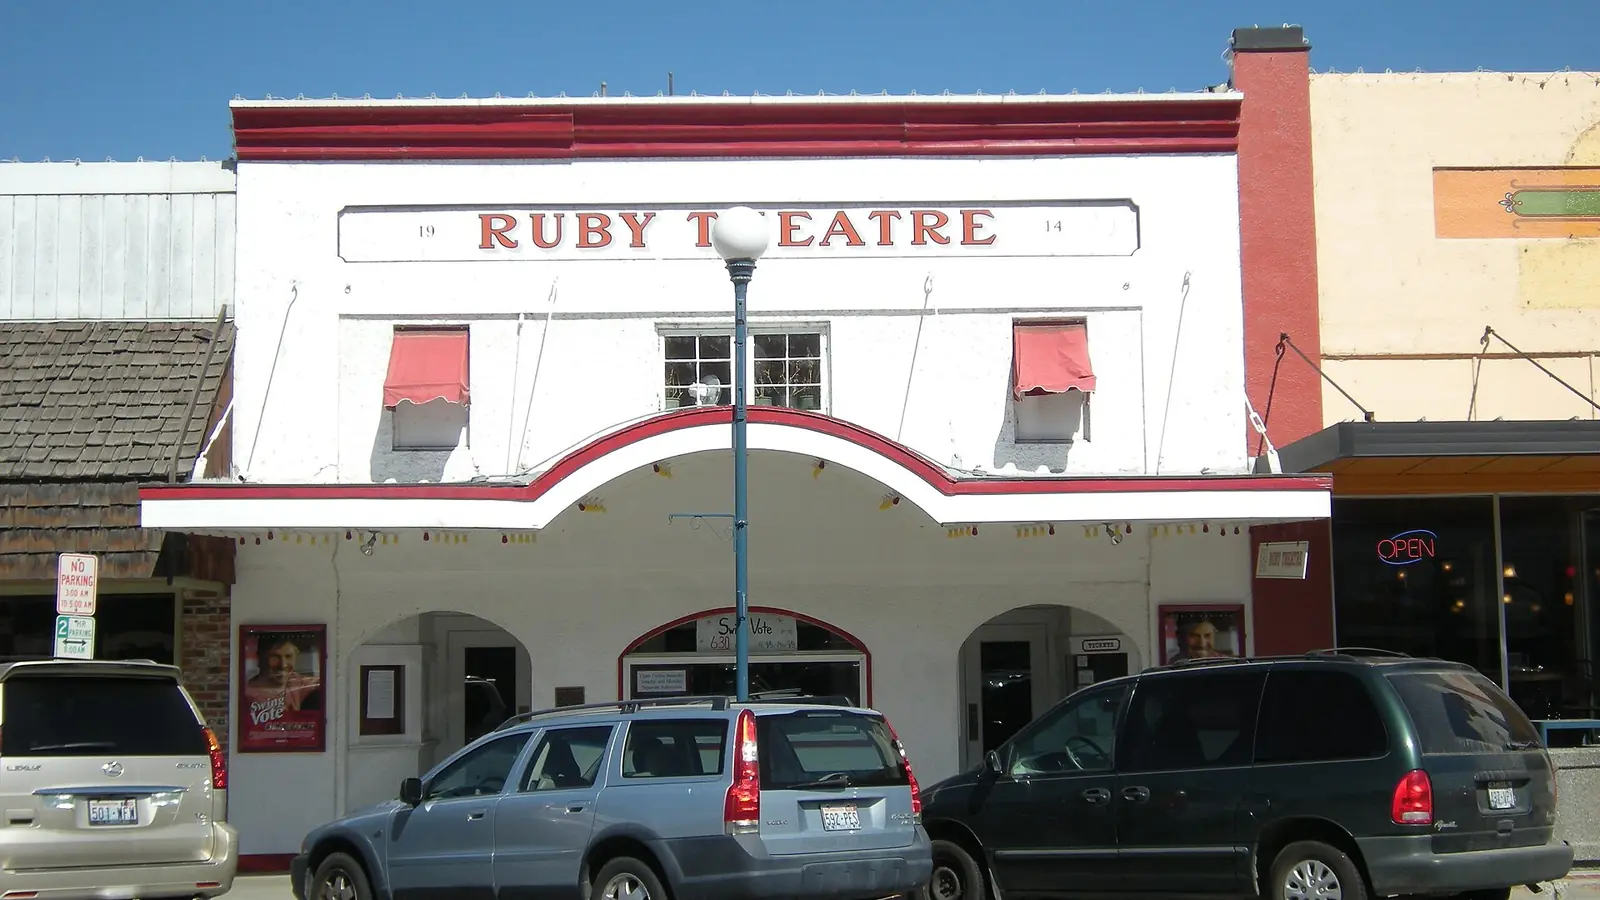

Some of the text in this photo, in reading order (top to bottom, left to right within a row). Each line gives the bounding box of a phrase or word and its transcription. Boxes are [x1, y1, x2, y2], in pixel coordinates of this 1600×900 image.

[418, 225, 435, 238] 19
[478, 209, 997, 249] RUBY TEATRE
[1044, 219, 1063, 233] 14
[1376, 537, 1436, 559] OPEN
[71, 561, 85, 573] NO
[61, 574, 94, 587] PARKING
[80, 590, 89, 598] AM
[84, 601, 92, 609] AM
[58, 619, 87, 636] 2 HR
[718, 616, 773, 636] Swi Vote
[69, 629, 92, 638] PARKING
[1087, 641, 1114, 649] TICKETS
[249, 696, 285, 713] Swing
[250, 706, 285, 726] Vote
